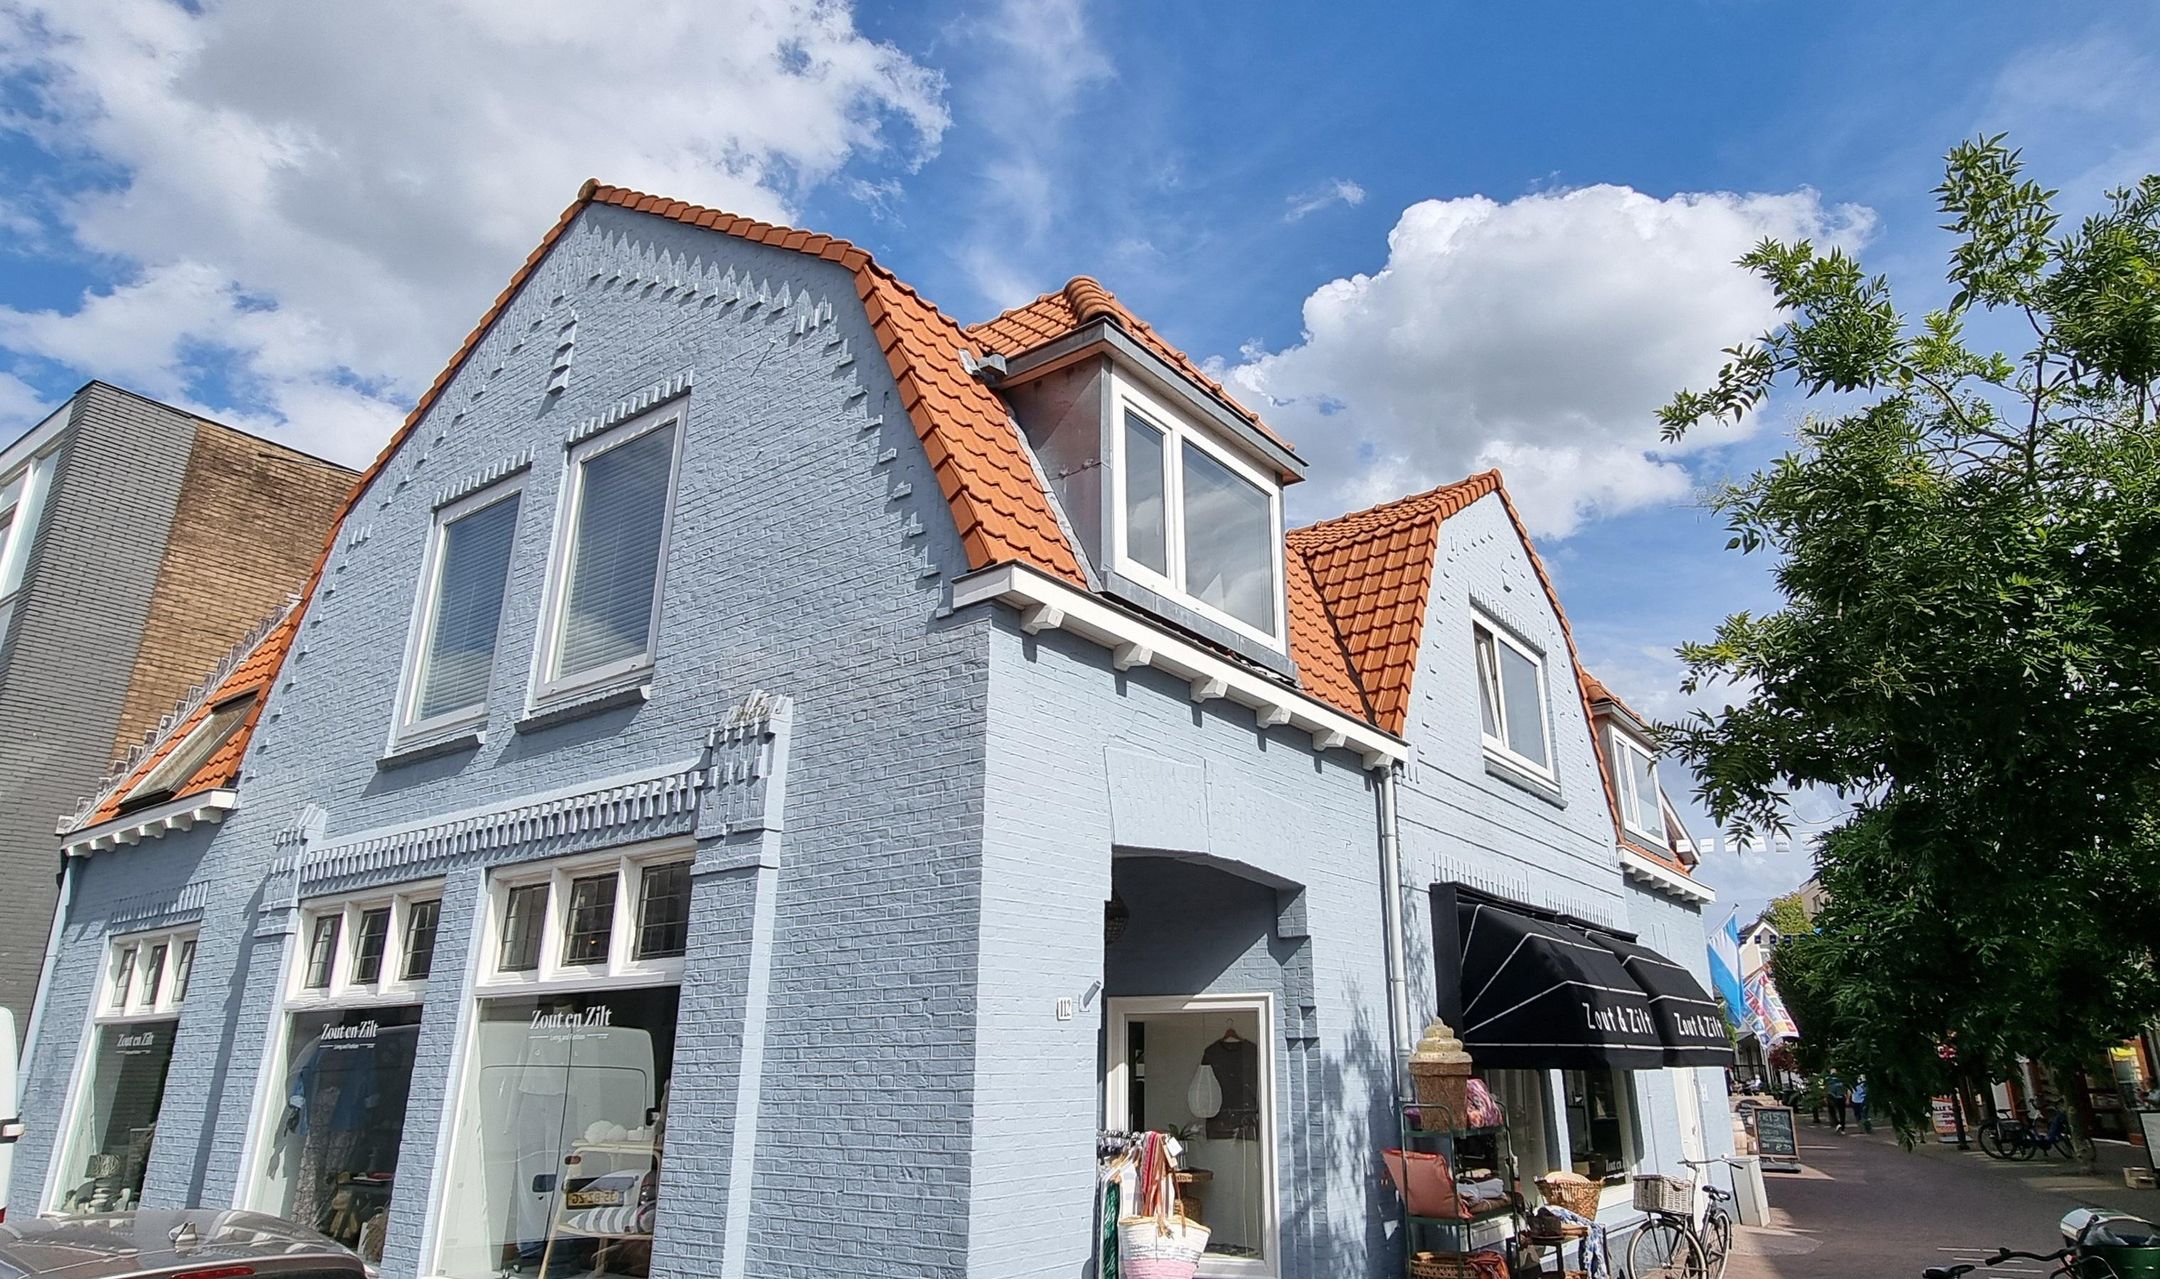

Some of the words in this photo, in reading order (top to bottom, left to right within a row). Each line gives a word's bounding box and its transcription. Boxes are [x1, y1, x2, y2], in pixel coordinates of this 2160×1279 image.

[530, 1010, 564, 1030] Zout
[565, 1012, 582, 1028] en
[584, 1005, 612, 1027] Zilt
[1060, 999, 1071, 1017] 112
[1582, 1002, 1617, 1032] Zout
[1617, 1006, 1629, 1033] &
[1626, 1008, 1654, 1035] Zilt
[321, 1023, 345, 1040] Zout
[345, 1026, 358, 1039] en
[358, 1020, 379, 1038] Zilt
[1674, 1012, 1699, 1036] Zout
[1697, 1015, 1706, 1037] &
[1703, 1016, 1725, 1038] Zilt
[117, 1034, 133, 1047] Zout
[133, 1036, 142, 1046] en
[141, 1032, 154, 1046] Zilt
